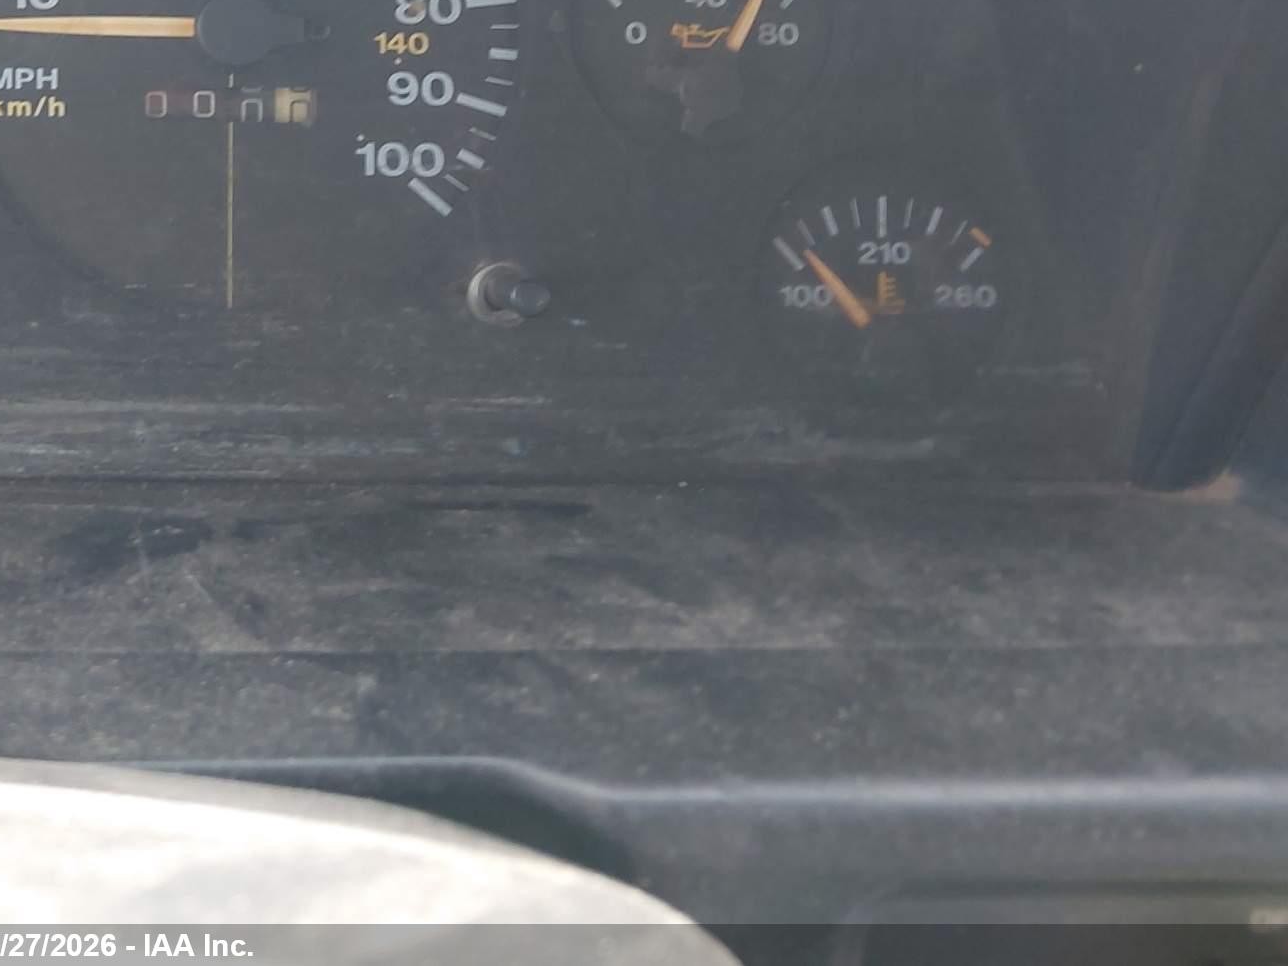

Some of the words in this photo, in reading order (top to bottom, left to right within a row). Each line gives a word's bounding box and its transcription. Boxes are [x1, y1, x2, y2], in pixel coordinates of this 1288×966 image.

[374, 32, 429, 55] 140
[625, 22, 647, 45] 0
[758, 23, 799, 46] 80
[387, 71, 454, 107] 90
[355, 141, 445, 178] 100
[858, 242, 910, 265] 210
[780, 285, 833, 308] 100
